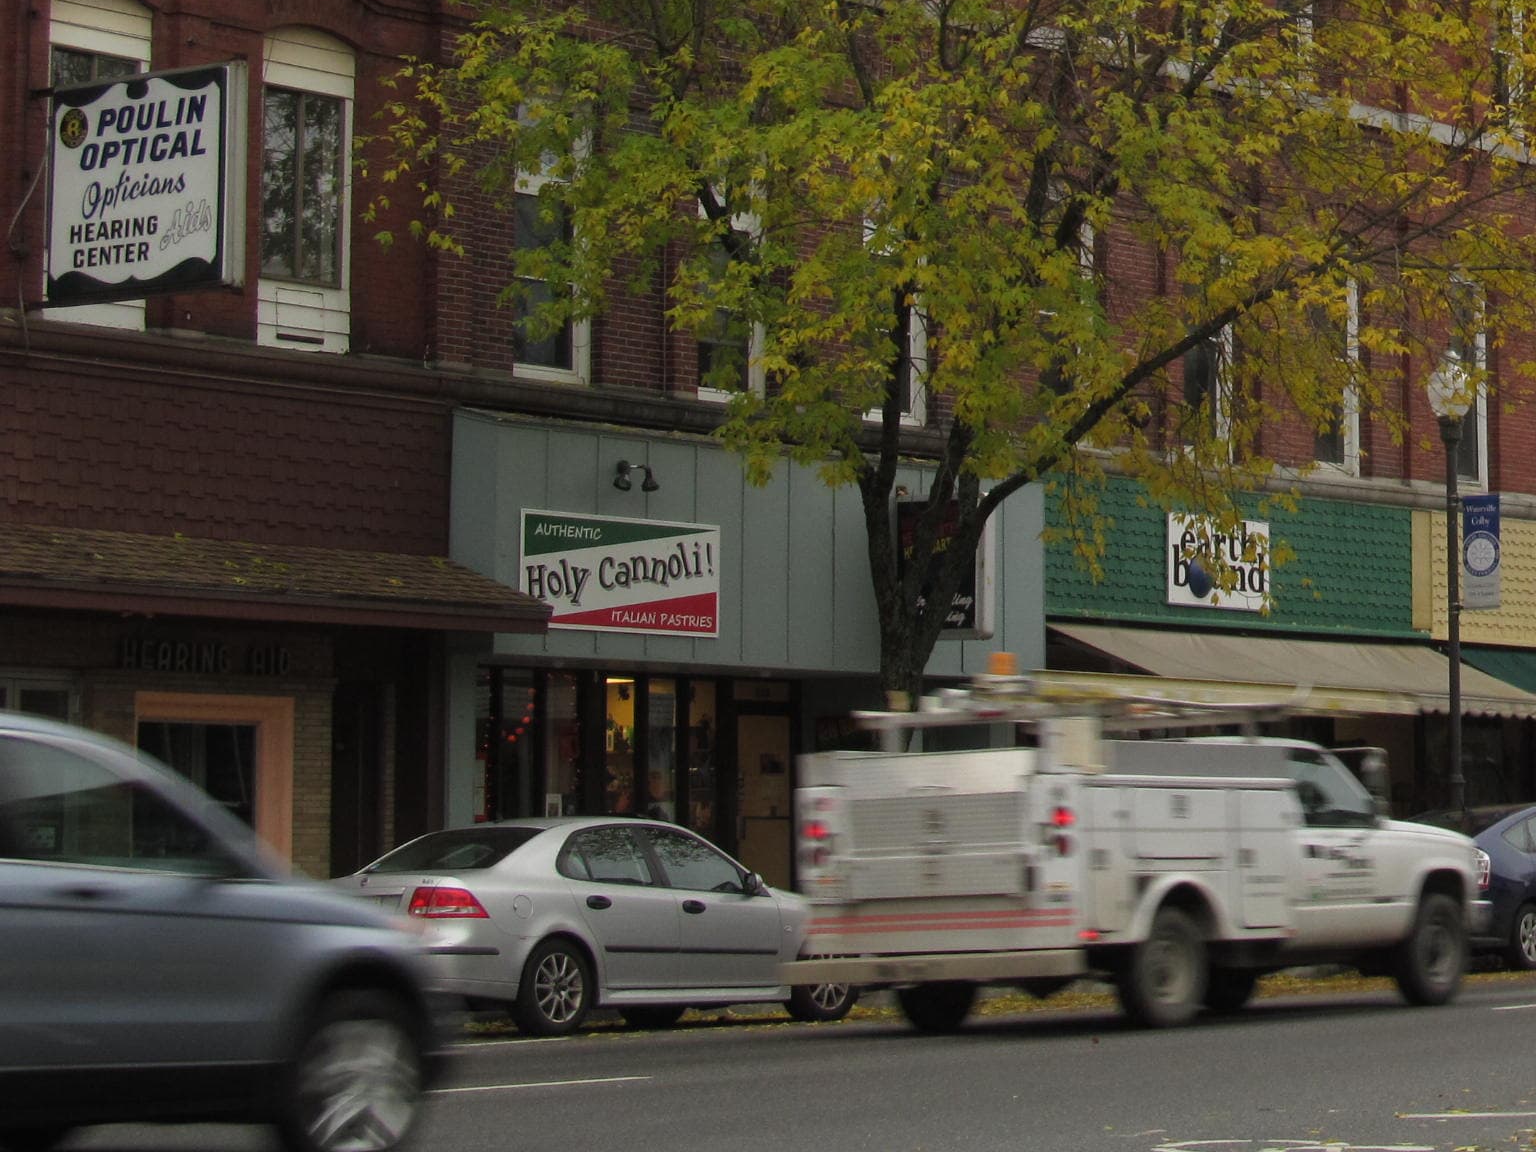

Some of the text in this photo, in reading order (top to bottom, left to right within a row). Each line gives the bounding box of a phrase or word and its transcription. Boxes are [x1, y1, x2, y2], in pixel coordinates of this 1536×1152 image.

[97, 94, 207, 137] POULIN
[80, 128, 206, 171] OPTICAL
[82, 170, 186, 219] Opticians
[70, 215, 158, 244] HEARING
[160, 199, 212, 251] Aids
[73, 241, 149, 269] CENTER
[1466, 504, 1497, 513] Waterville
[534, 522, 602, 540] AUTHENTIC
[526, 542, 714, 606] Holy Cannoli!
[611, 610, 713, 628] ITALIAN PASTRIES
[123, 640, 230, 672] HEARING
